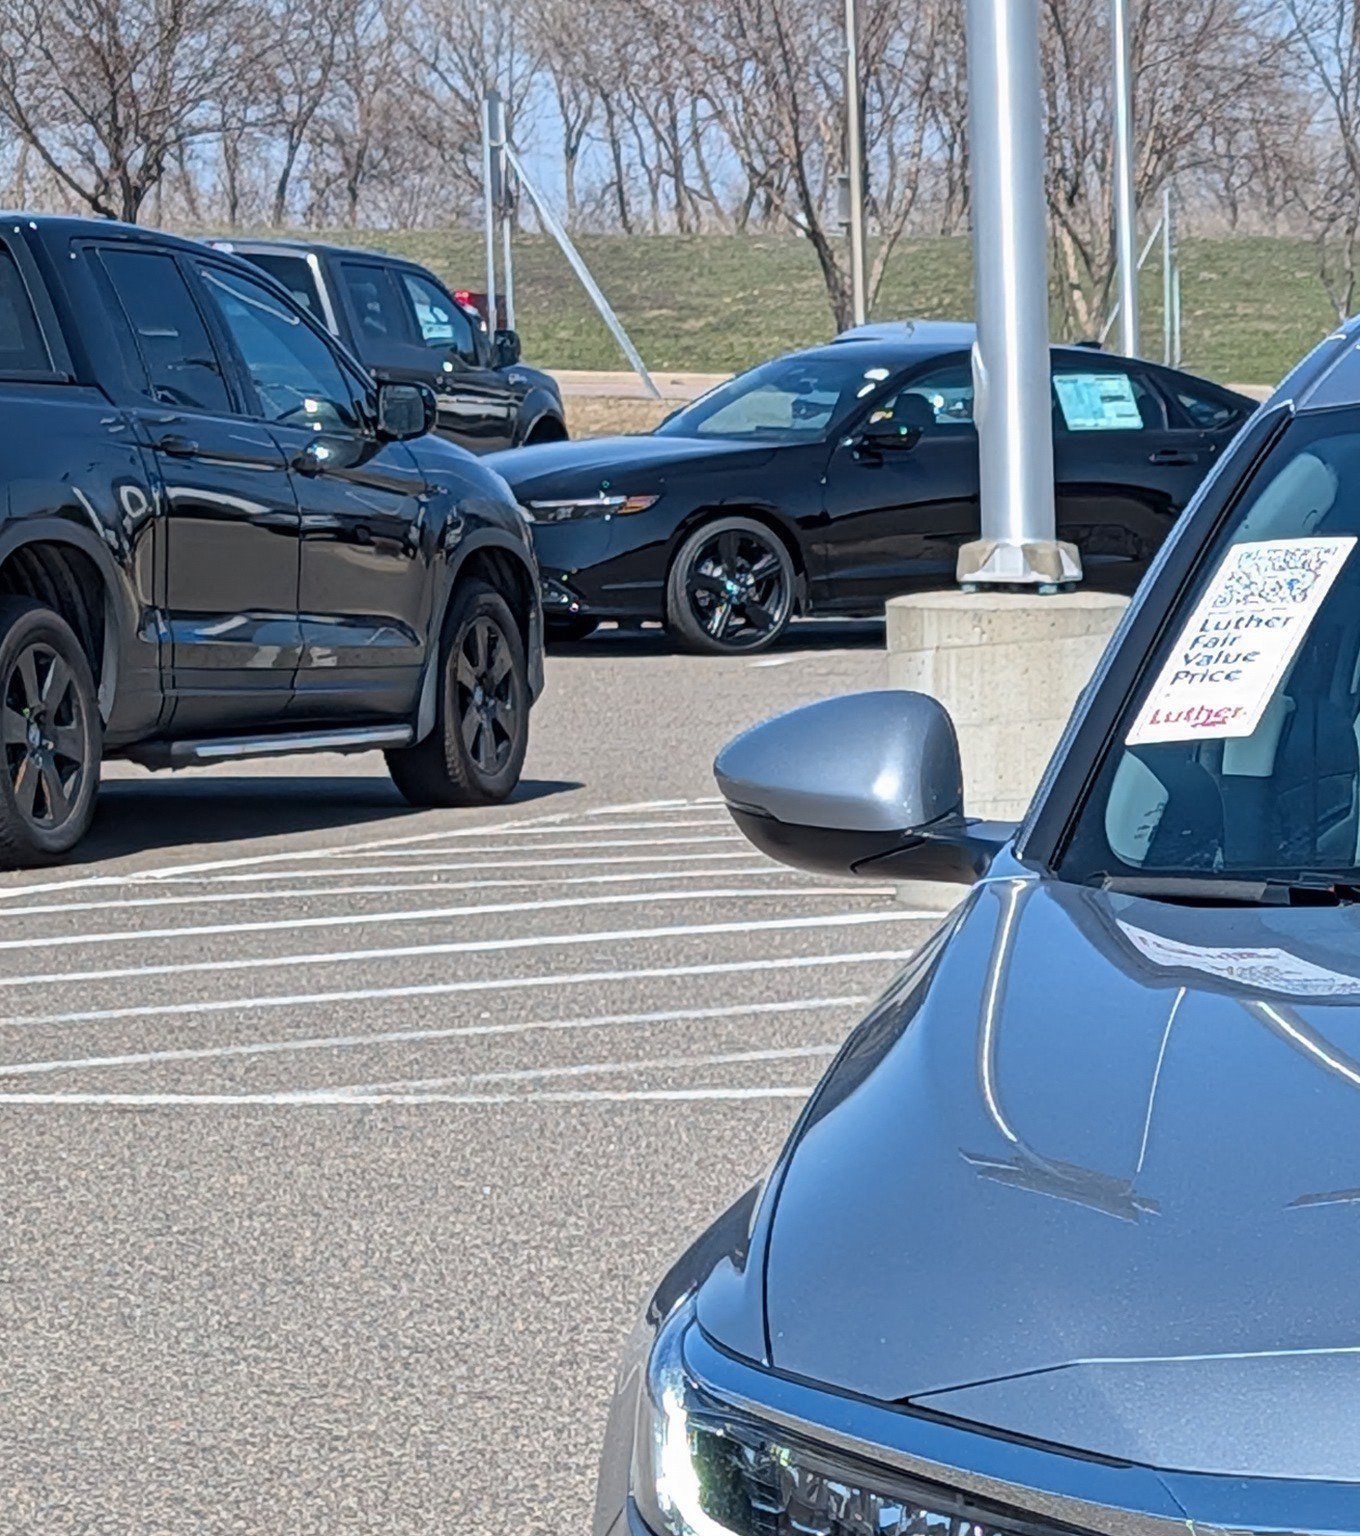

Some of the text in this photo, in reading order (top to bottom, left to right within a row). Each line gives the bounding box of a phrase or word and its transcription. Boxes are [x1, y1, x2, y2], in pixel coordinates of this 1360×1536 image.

[1199, 614, 1295, 633] Luther
[1188, 633, 1243, 651] Fair
[1183, 650, 1261, 667] Value
[1169, 668, 1243, 686] Price
